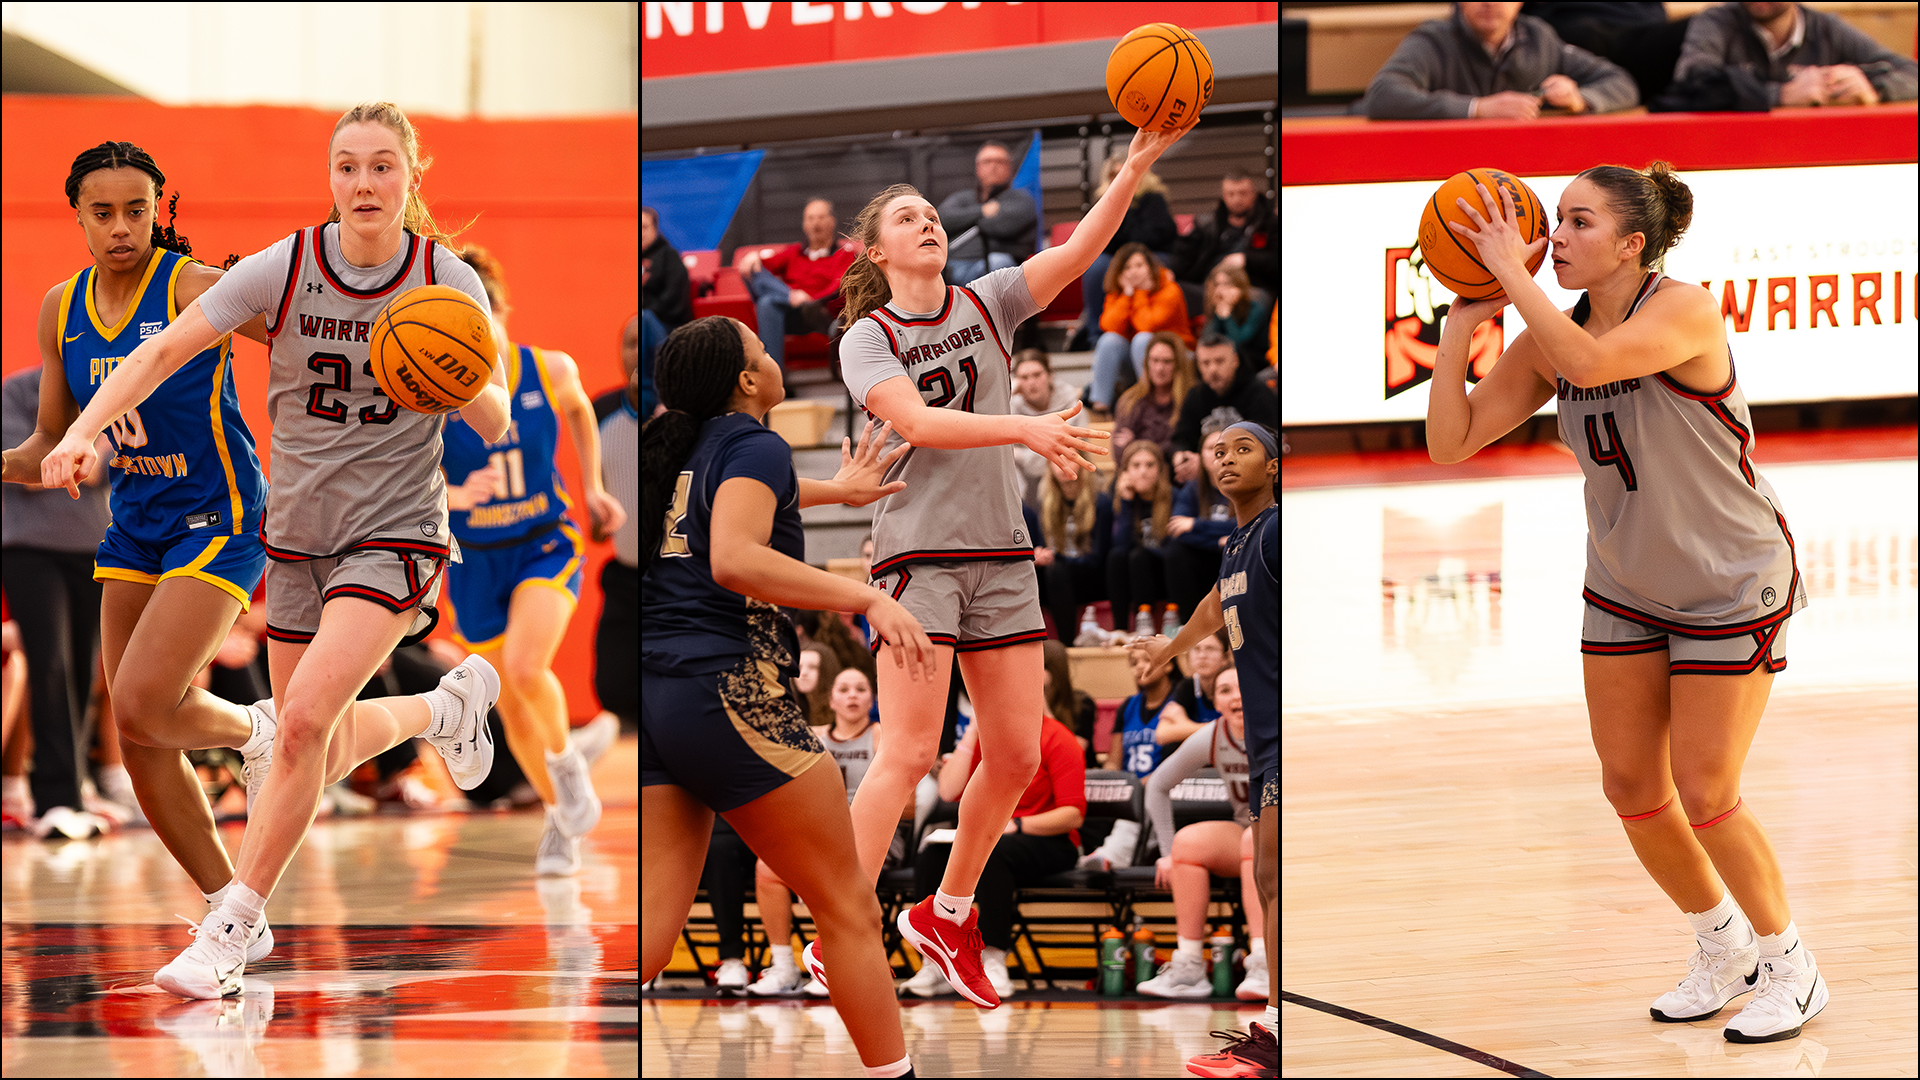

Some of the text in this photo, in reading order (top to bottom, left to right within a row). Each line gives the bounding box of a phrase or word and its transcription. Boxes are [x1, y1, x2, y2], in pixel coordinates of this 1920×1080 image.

[1732, 243, 1794, 264] EAST
[1701, 271, 1918, 332] WARRI
[432, 352, 480, 388] EVO
[901, 324, 985, 371] WARRIORS
[917, 355, 978, 413] 21
[1584, 411, 1638, 492] 4
[1127, 743, 1154, 772] 15
